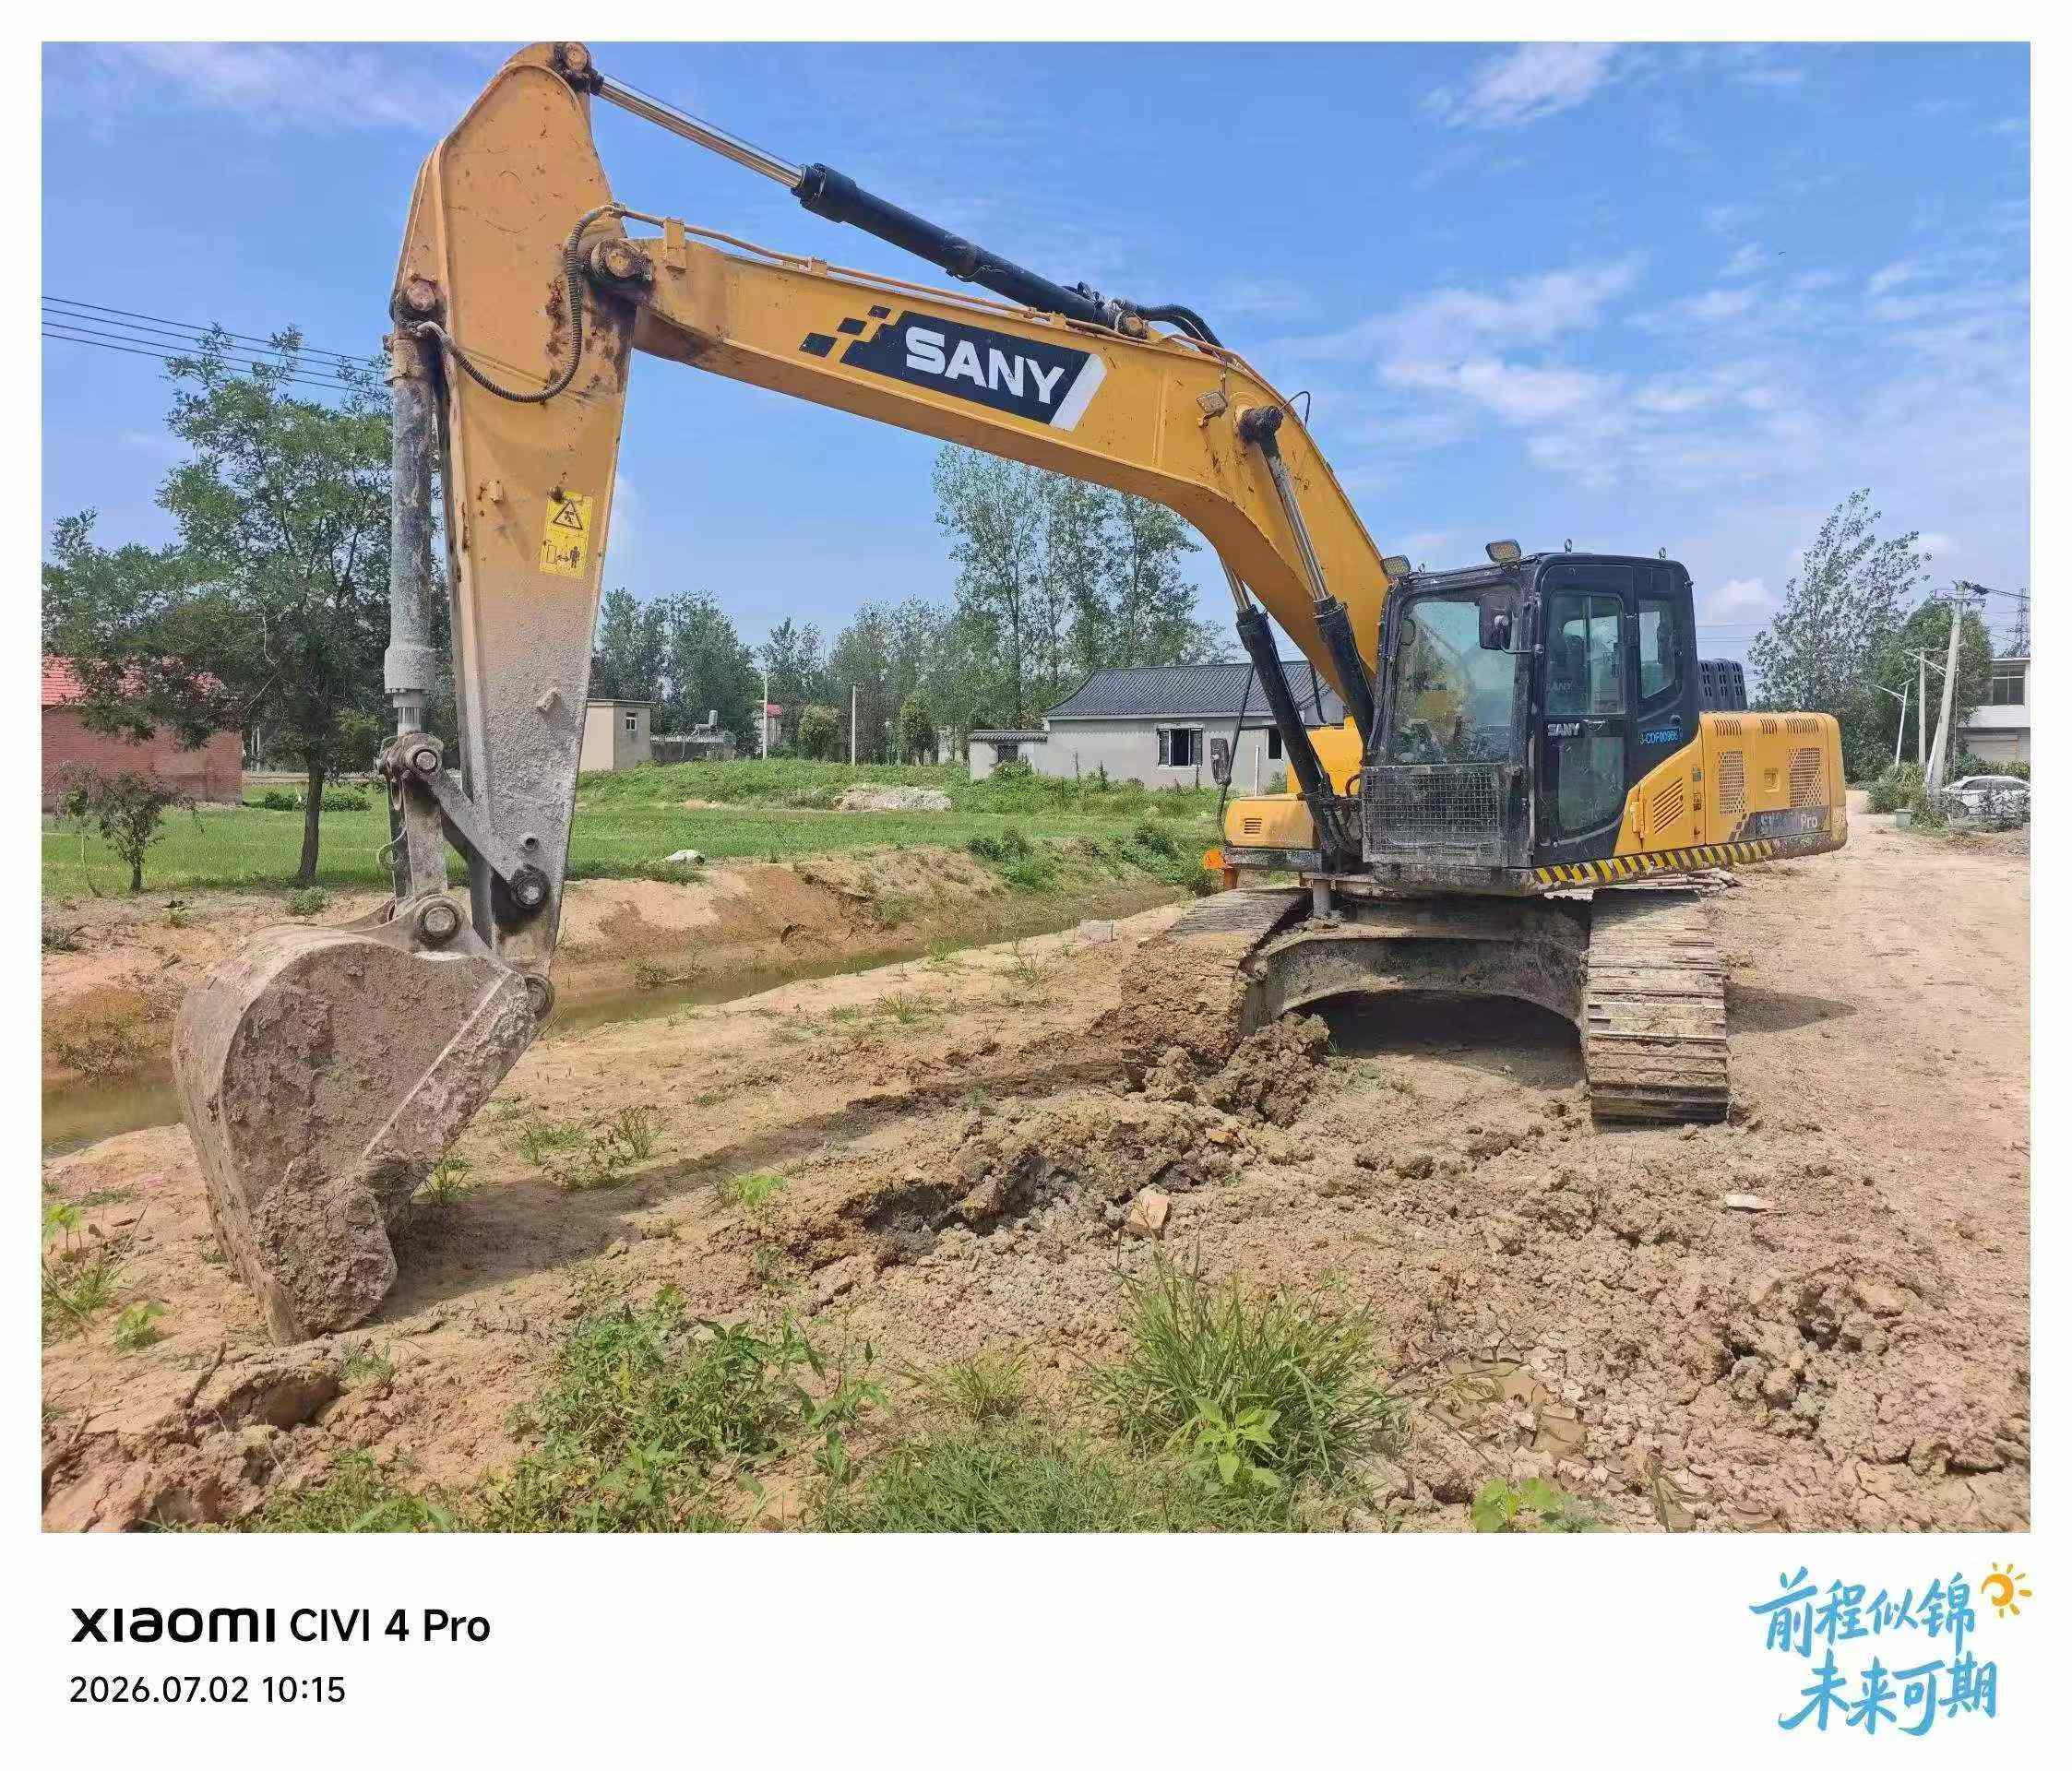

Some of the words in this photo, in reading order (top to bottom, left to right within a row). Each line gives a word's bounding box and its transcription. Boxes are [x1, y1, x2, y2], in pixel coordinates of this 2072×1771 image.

[905, 326, 1065, 404] SANY
[1547, 722, 1580, 737] SANY
[1800, 813, 1818, 829] Pro
